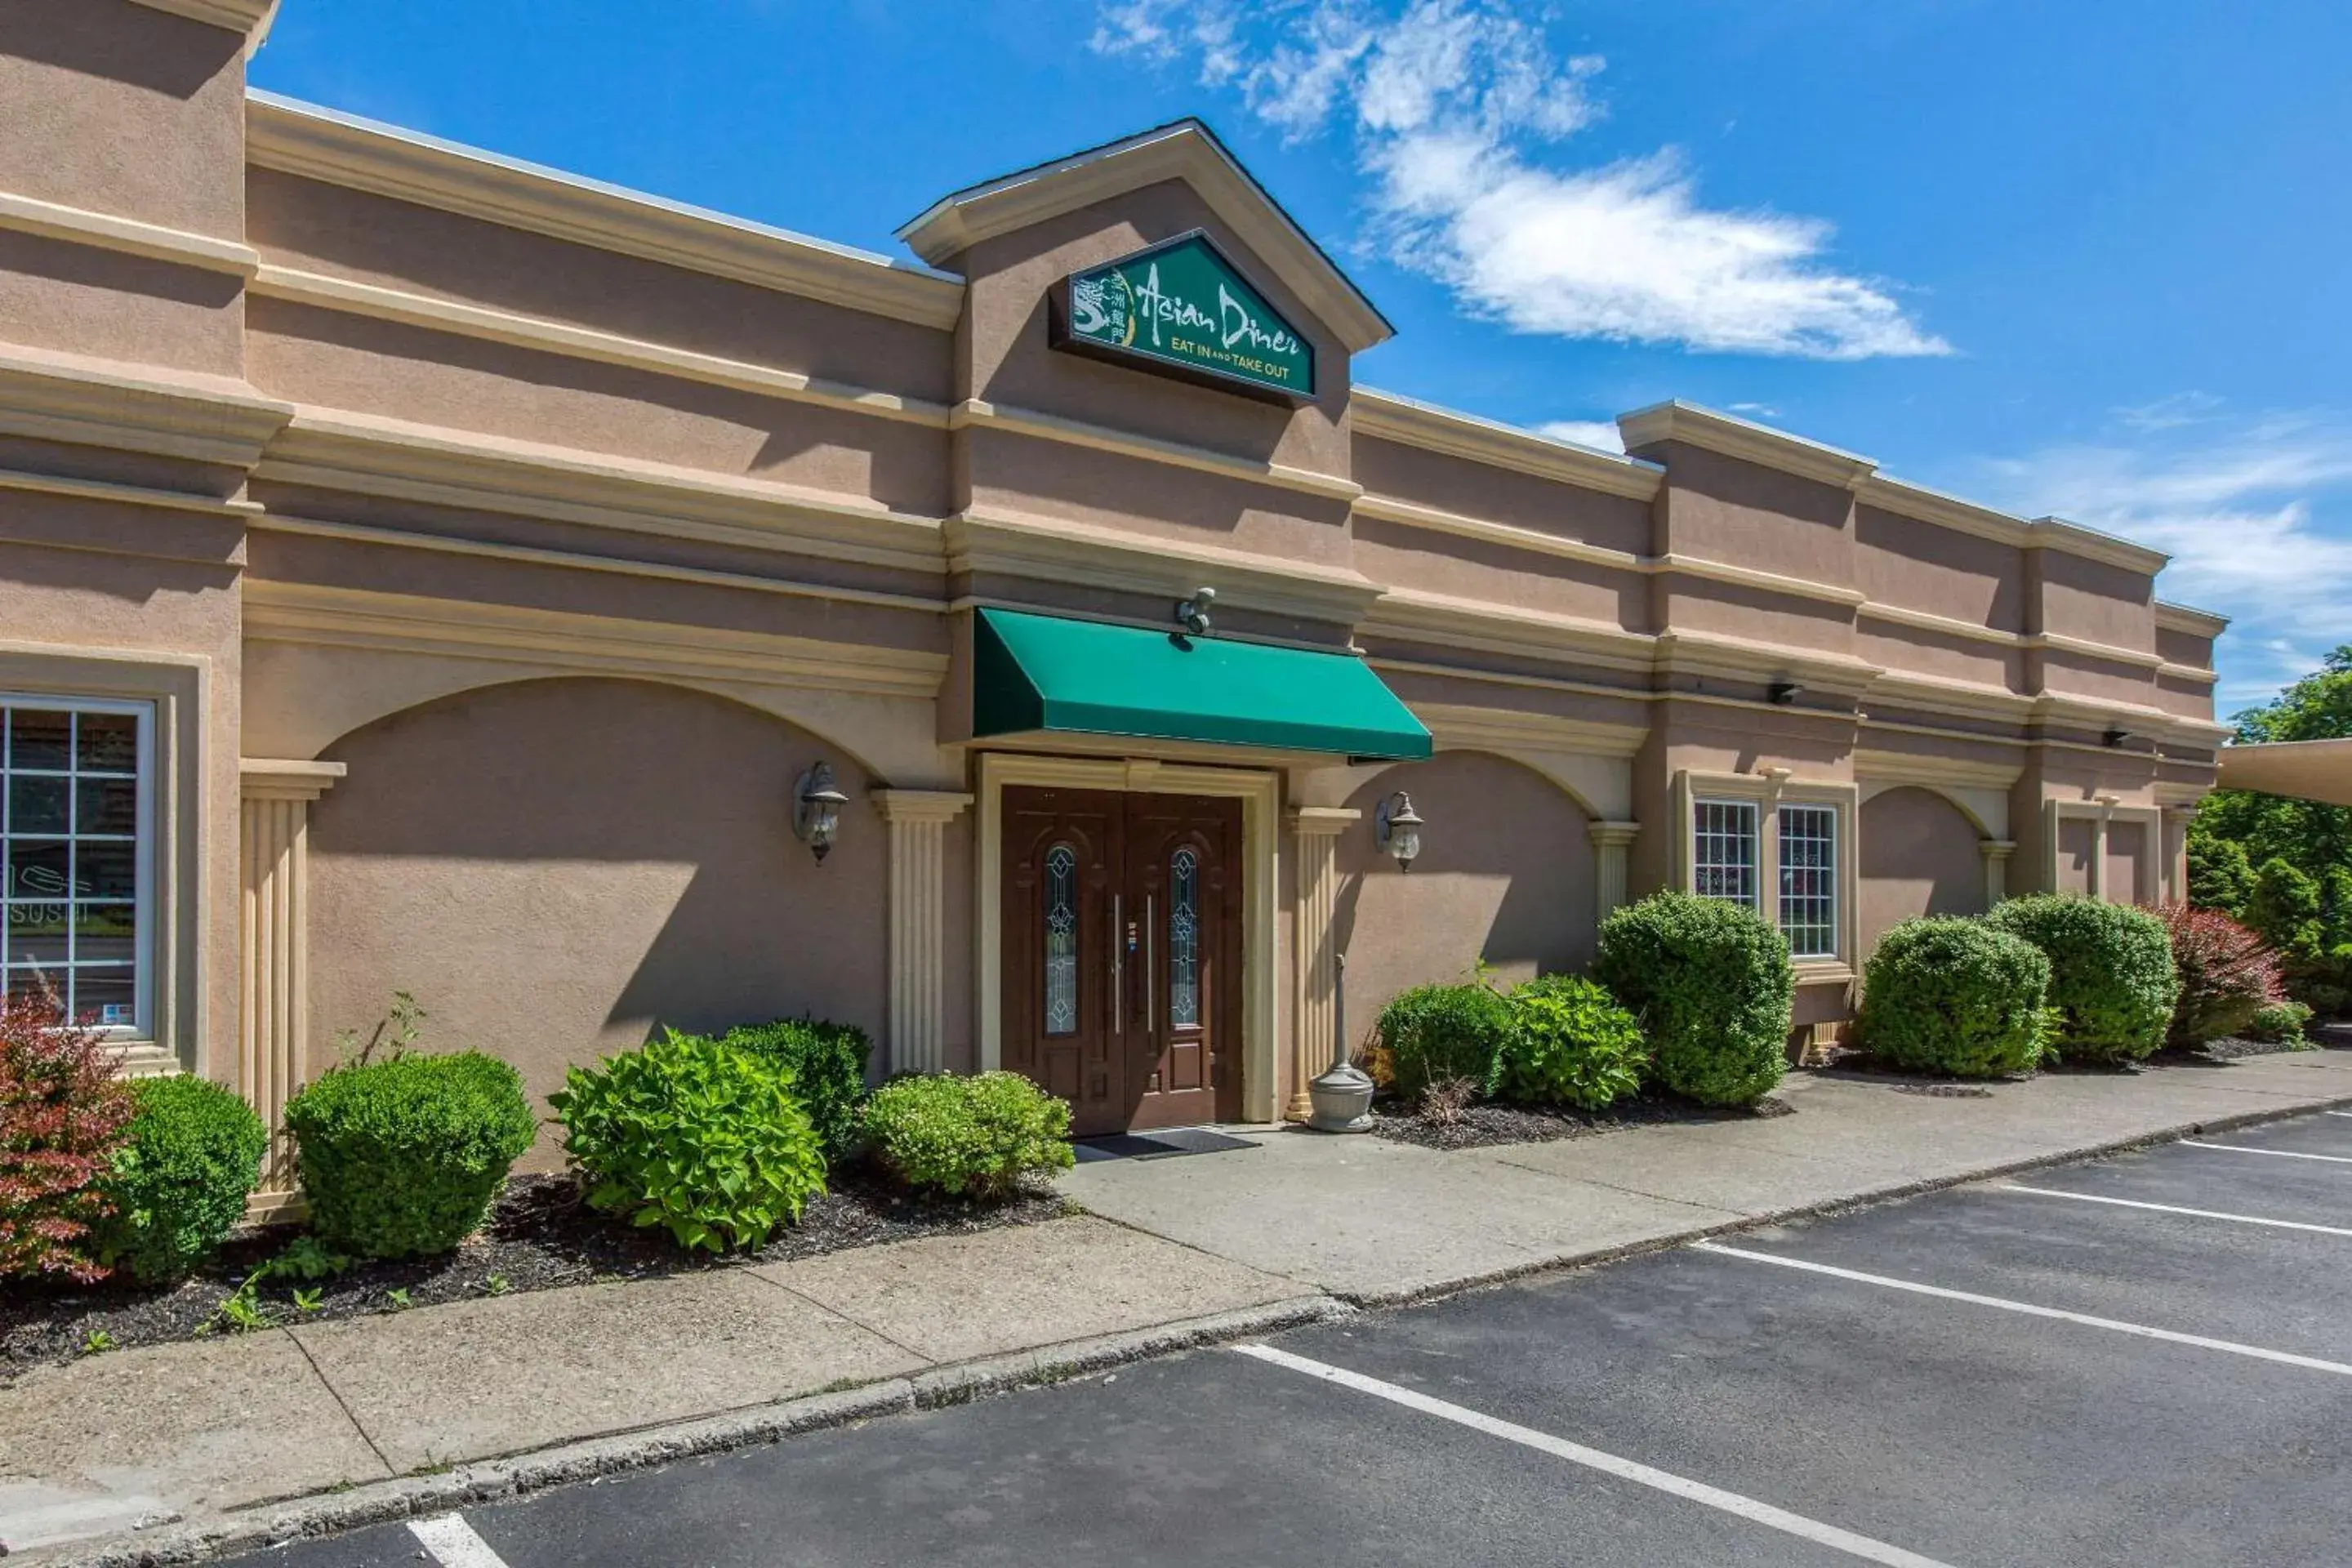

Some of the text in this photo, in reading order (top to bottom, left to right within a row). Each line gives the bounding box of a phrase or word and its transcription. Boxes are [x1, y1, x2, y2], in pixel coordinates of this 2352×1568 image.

[1136, 263, 1299, 355] Asian Diner
[1171, 336, 1195, 354] EAT
[1197, 345, 1211, 359] IN
[1232, 354, 1263, 372] TAKE
[1264, 363, 1290, 380] OUT
